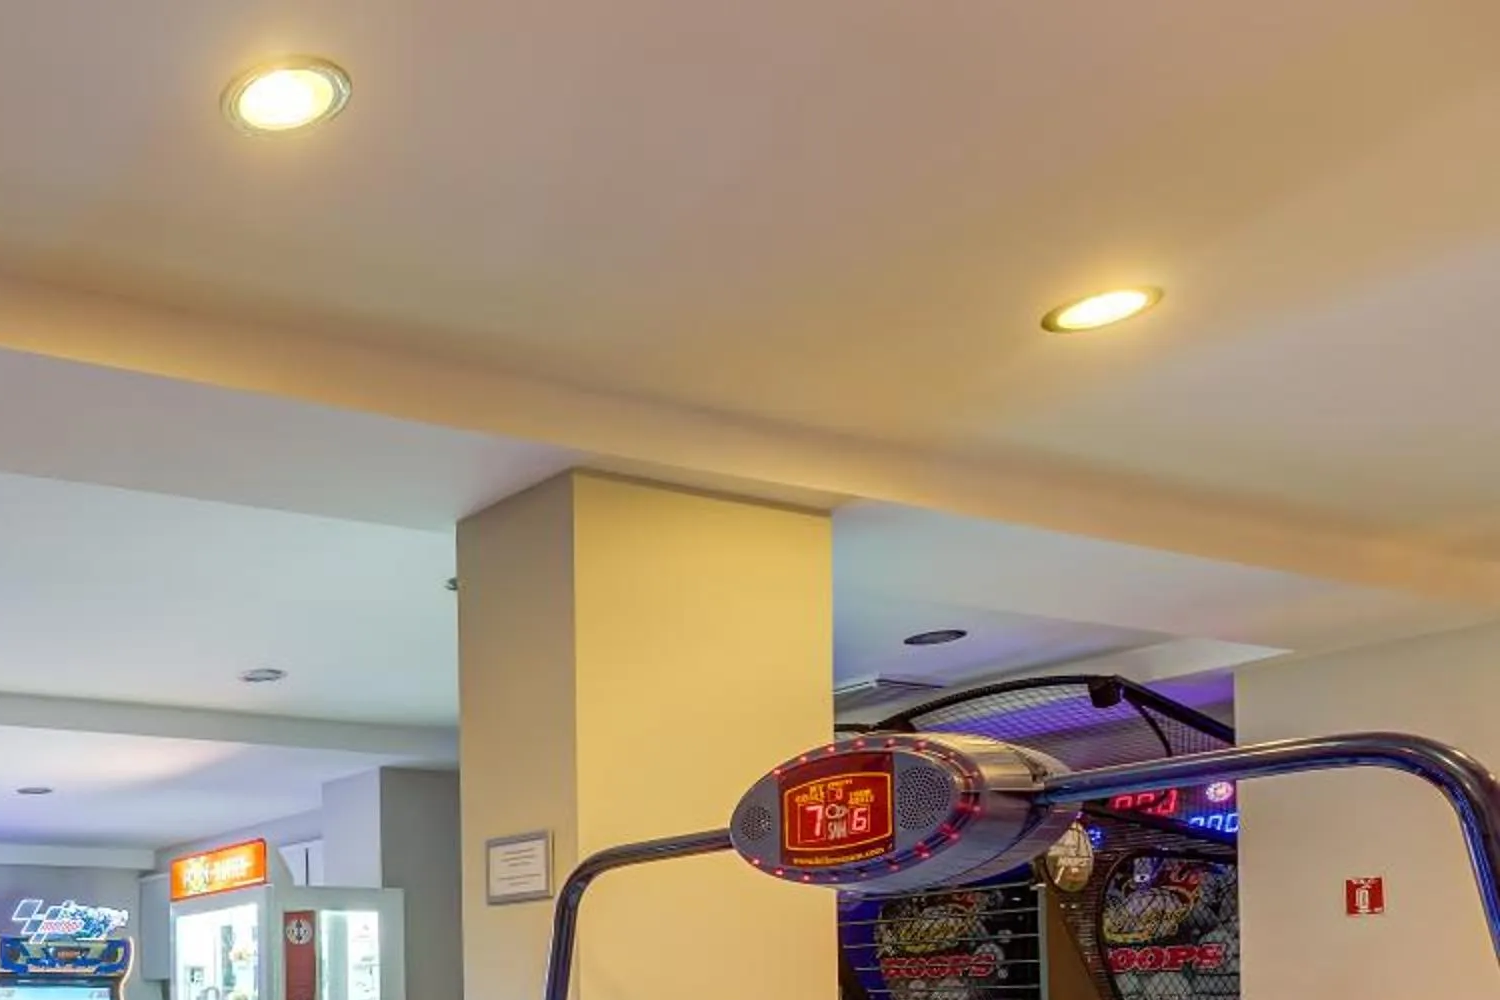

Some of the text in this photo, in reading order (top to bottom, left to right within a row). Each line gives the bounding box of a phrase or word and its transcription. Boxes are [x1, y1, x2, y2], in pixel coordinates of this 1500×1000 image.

[804, 804, 868, 837] 7 6
[1107, 942, 1227, 974] OOPS
